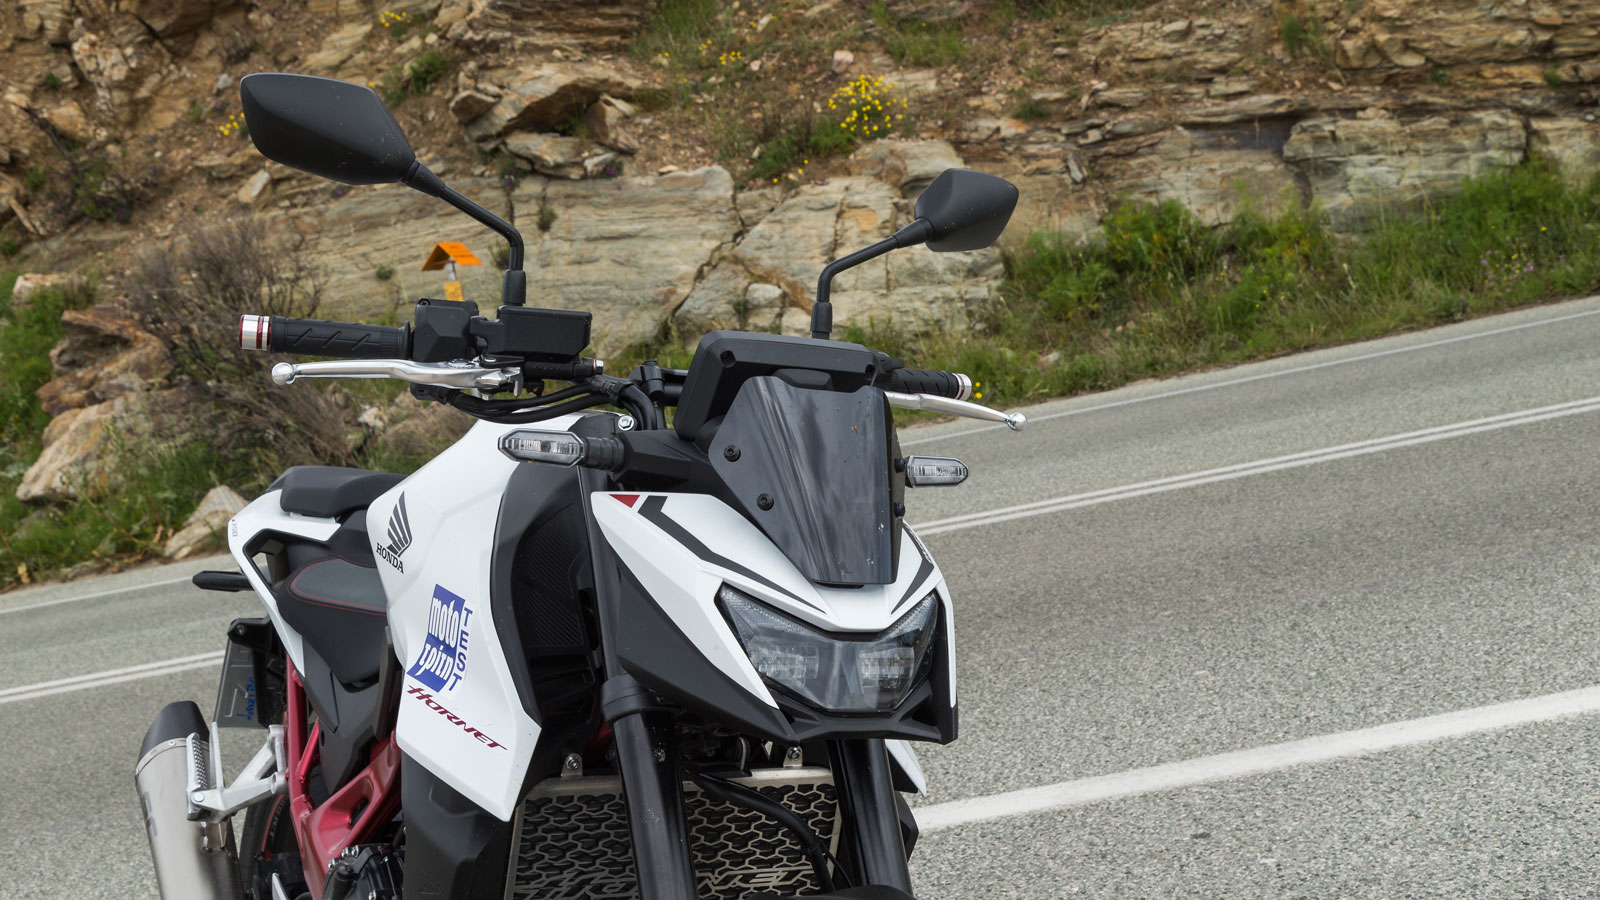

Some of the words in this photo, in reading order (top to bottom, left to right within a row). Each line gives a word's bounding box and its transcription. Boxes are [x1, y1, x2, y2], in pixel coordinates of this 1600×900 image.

[376, 542, 404, 574] HONDA
[428, 597, 460, 648] moto
[448, 606, 473, 691] TEST
[407, 684, 508, 750] HORNET
